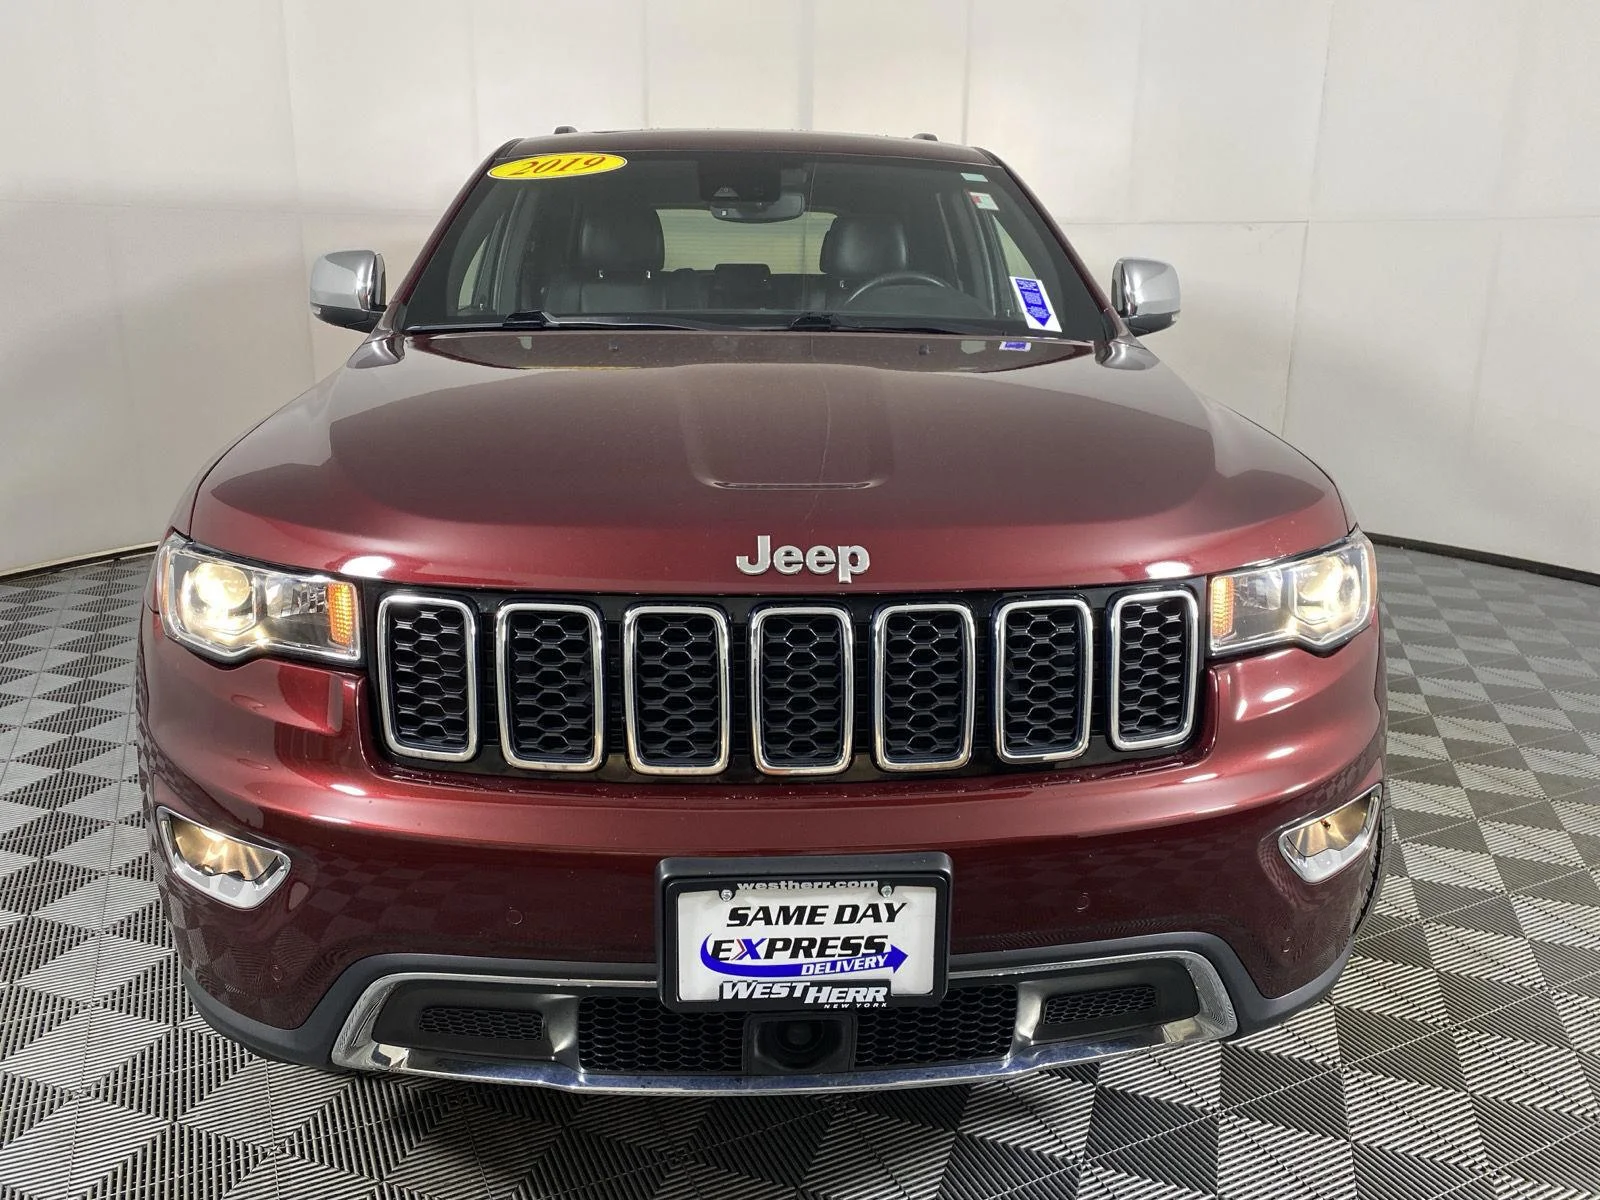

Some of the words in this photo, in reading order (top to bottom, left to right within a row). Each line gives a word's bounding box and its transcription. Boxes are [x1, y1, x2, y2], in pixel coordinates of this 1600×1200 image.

[507, 156, 606, 176] 2019
[736, 535, 870, 583] Jeep
[737, 880, 879, 890] westherr.com
[726, 905, 829, 927] SAME
[833, 903, 907, 925] DAY
[711, 935, 889, 961] EXPRESS
[801, 955, 889, 976] DELIVERY
